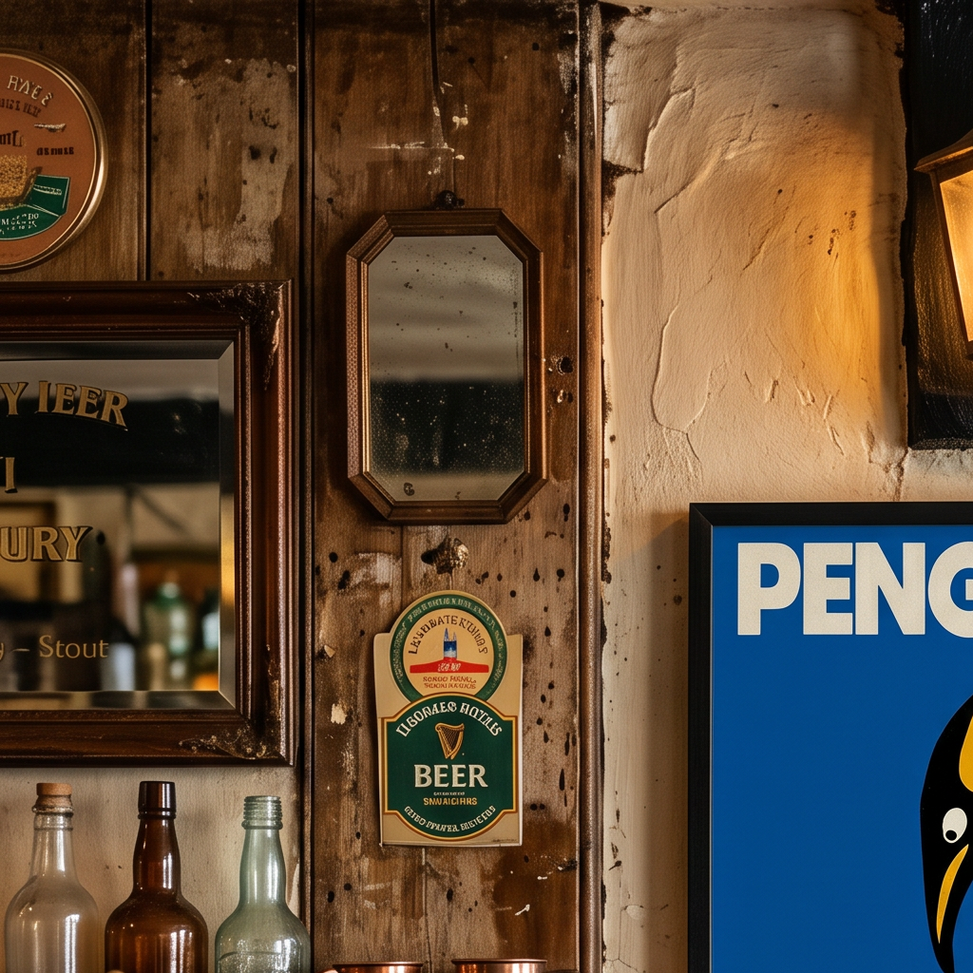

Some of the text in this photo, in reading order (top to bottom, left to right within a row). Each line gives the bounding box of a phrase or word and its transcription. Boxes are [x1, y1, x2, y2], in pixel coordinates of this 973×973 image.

[0, 526, 93, 562] URY
[39, 634, 109, 659] Stout
[413, 764, 489, 788] BEER
